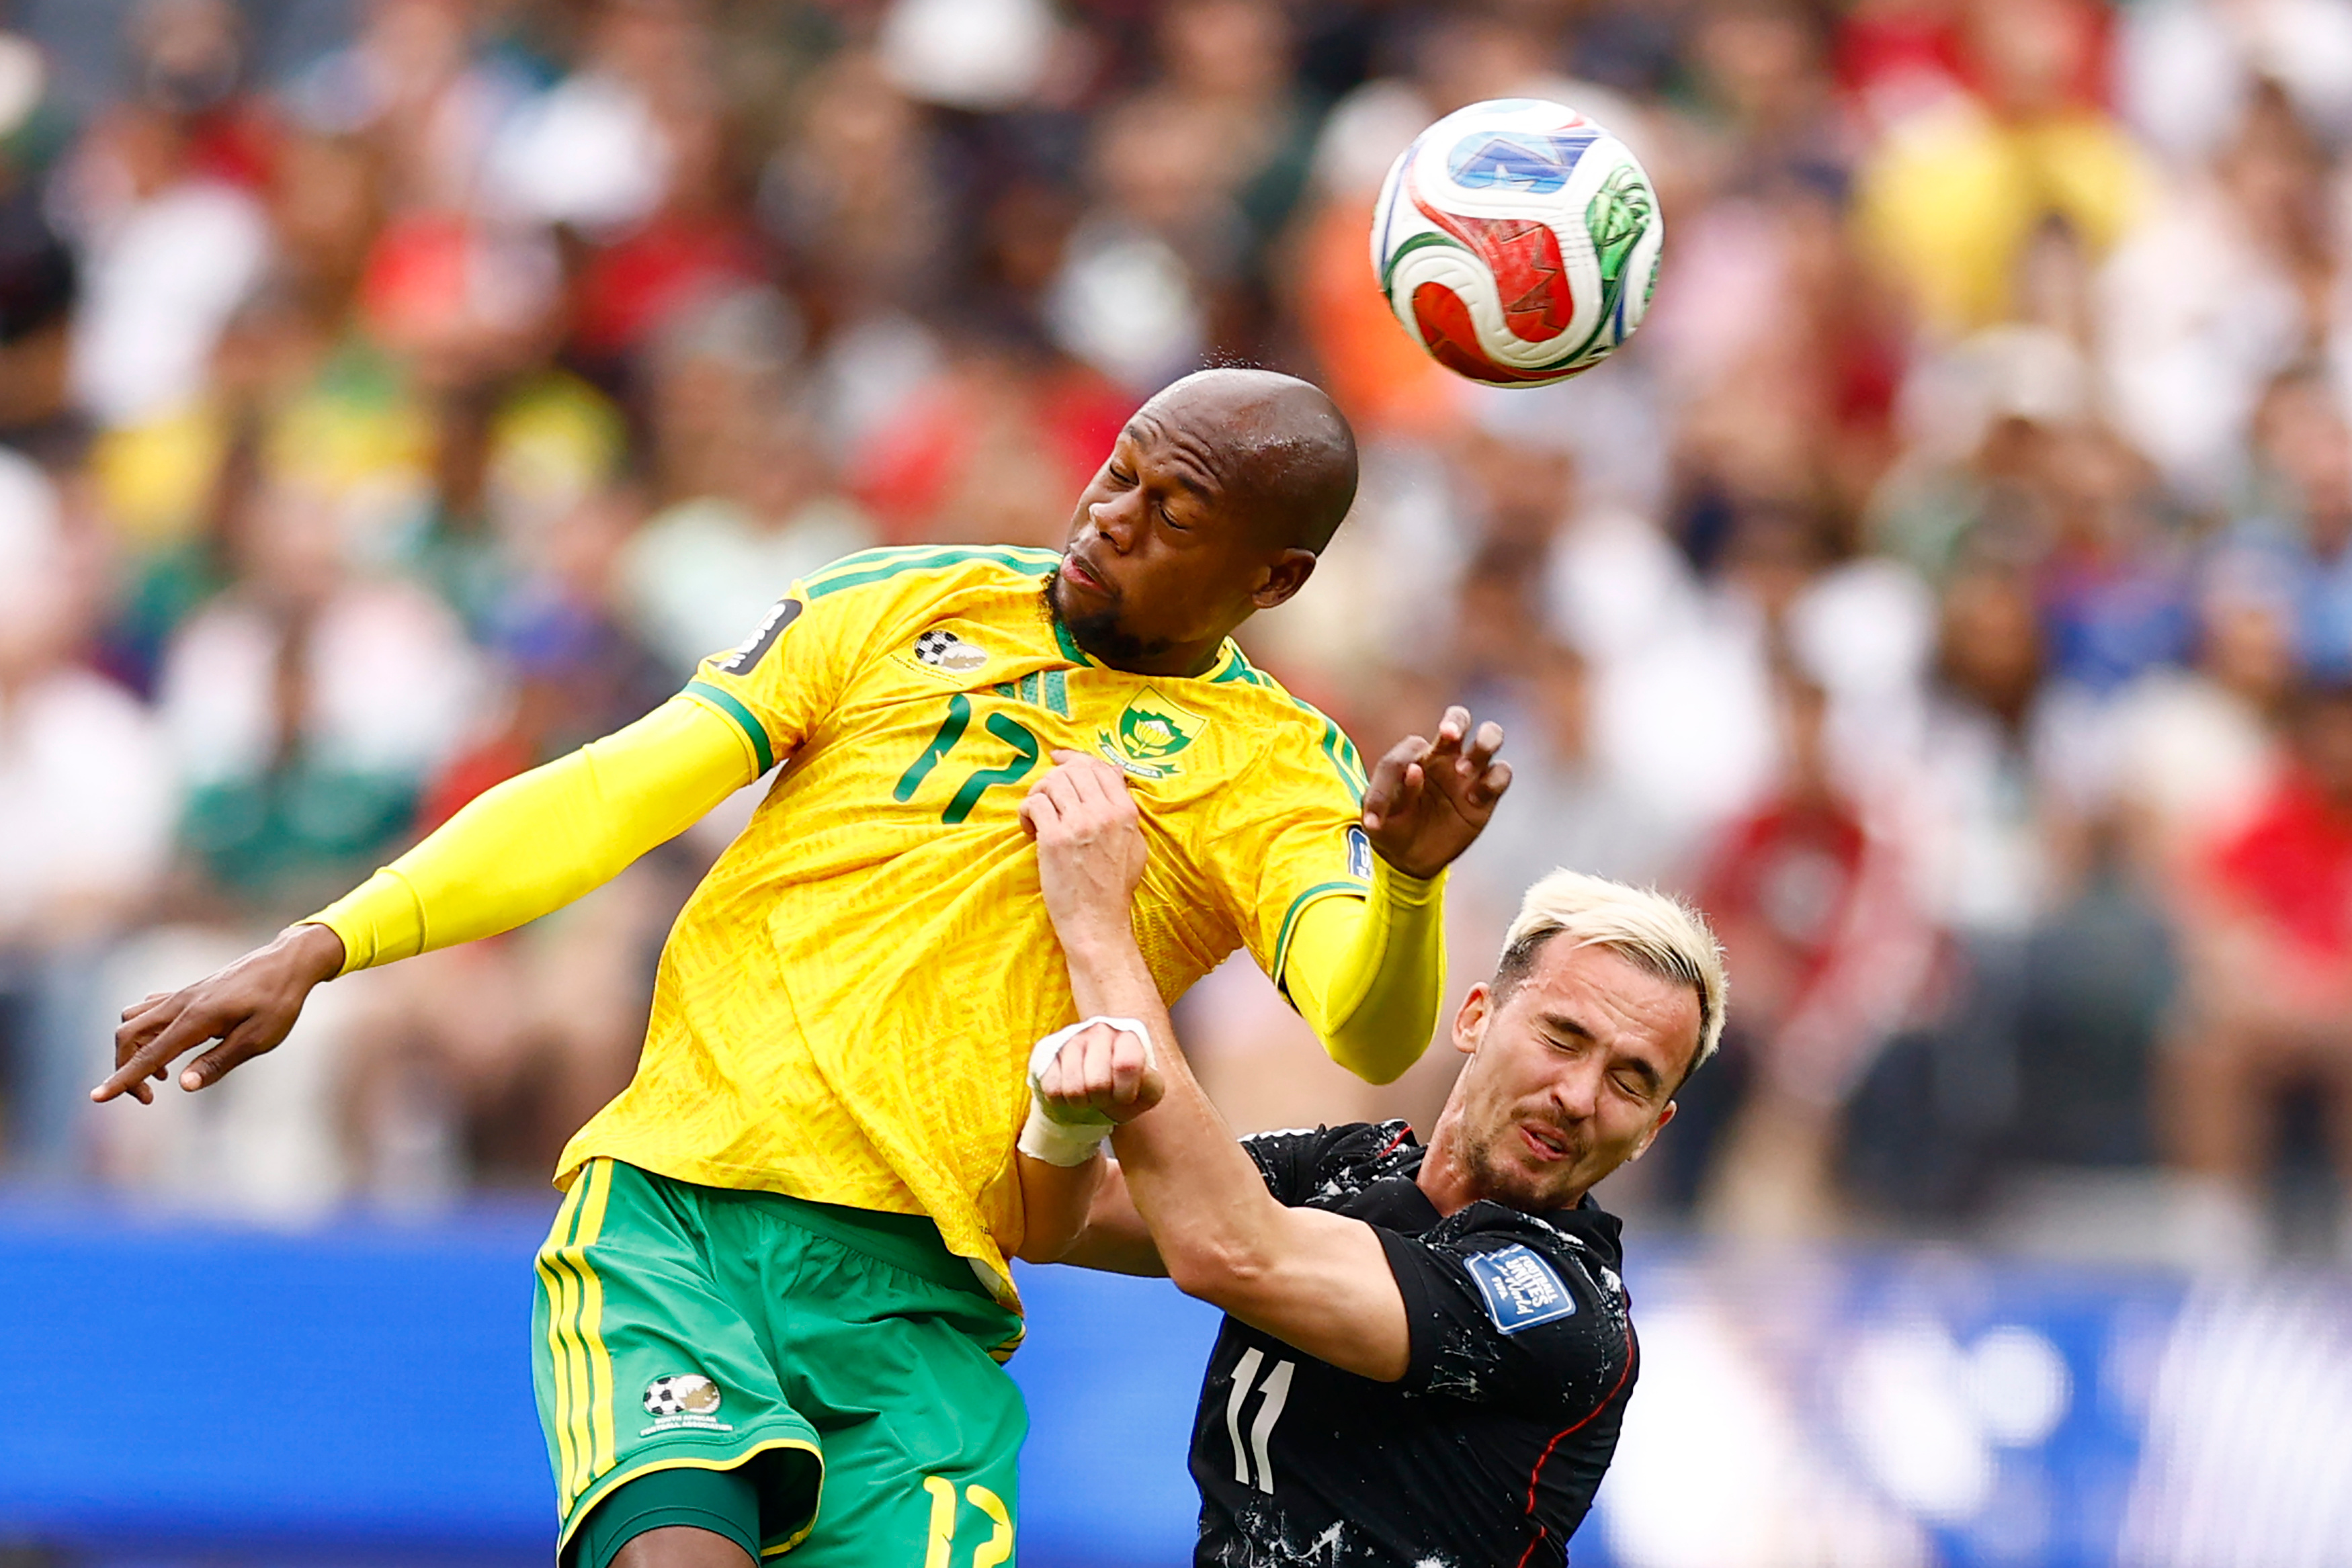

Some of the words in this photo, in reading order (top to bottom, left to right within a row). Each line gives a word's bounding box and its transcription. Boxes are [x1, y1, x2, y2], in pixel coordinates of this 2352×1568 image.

[1124, 764, 1159, 777] AFRICA
[1491, 1276, 1509, 1301] FIFA
[1505, 1258, 1548, 1307] UNITES
[1505, 1277, 1534, 1315] World
[1518, 1255, 1558, 1303] FOOTBALL
[1226, 1346, 1296, 1495] 11
